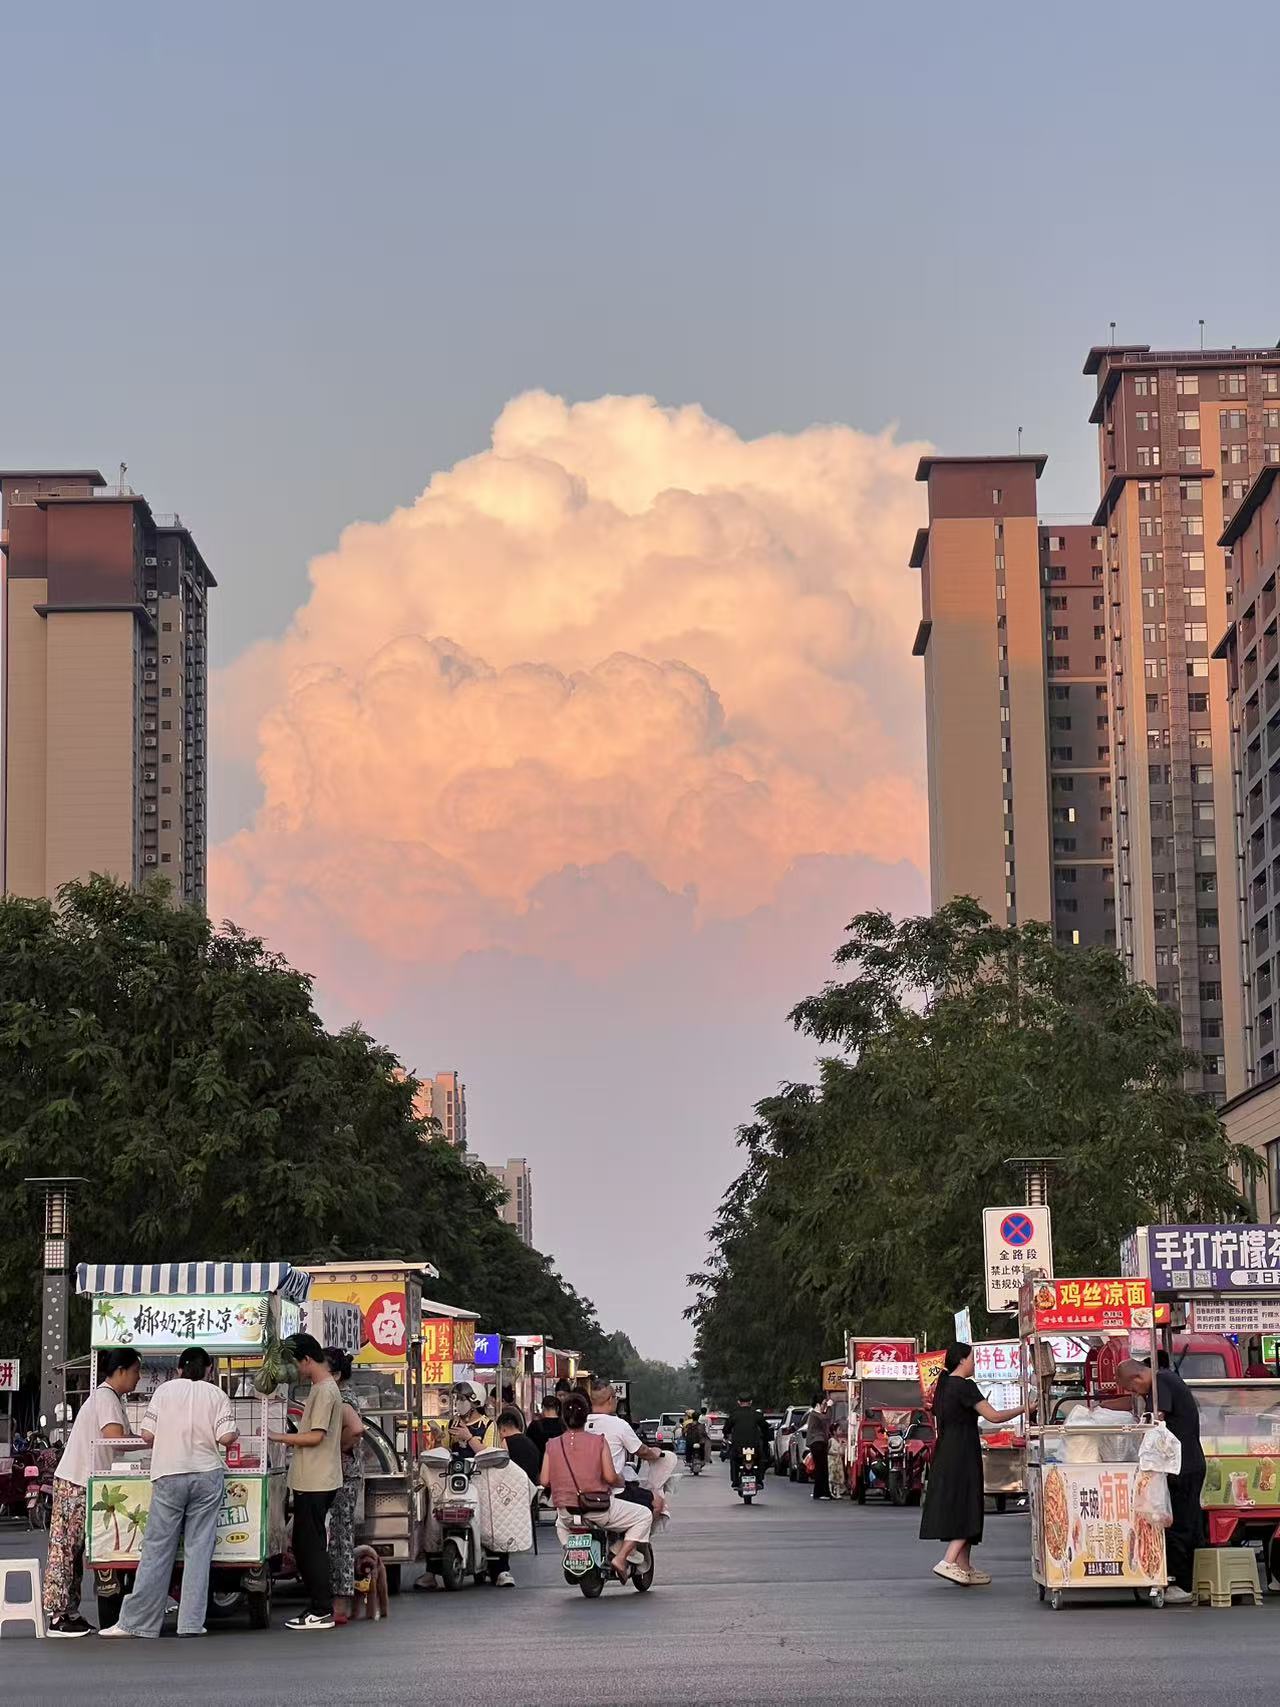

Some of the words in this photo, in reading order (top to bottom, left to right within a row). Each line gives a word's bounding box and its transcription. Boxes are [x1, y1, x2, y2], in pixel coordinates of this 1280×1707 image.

[999, 1249, 1037, 1260] 全路段
[1060, 1281, 1146, 1307] 鸡丝凉面
[133, 1304, 233, 1339] 椰奶清补凉
[439, 1322, 450, 1360] 小丸子
[424, 1362, 444, 1382] 饼
